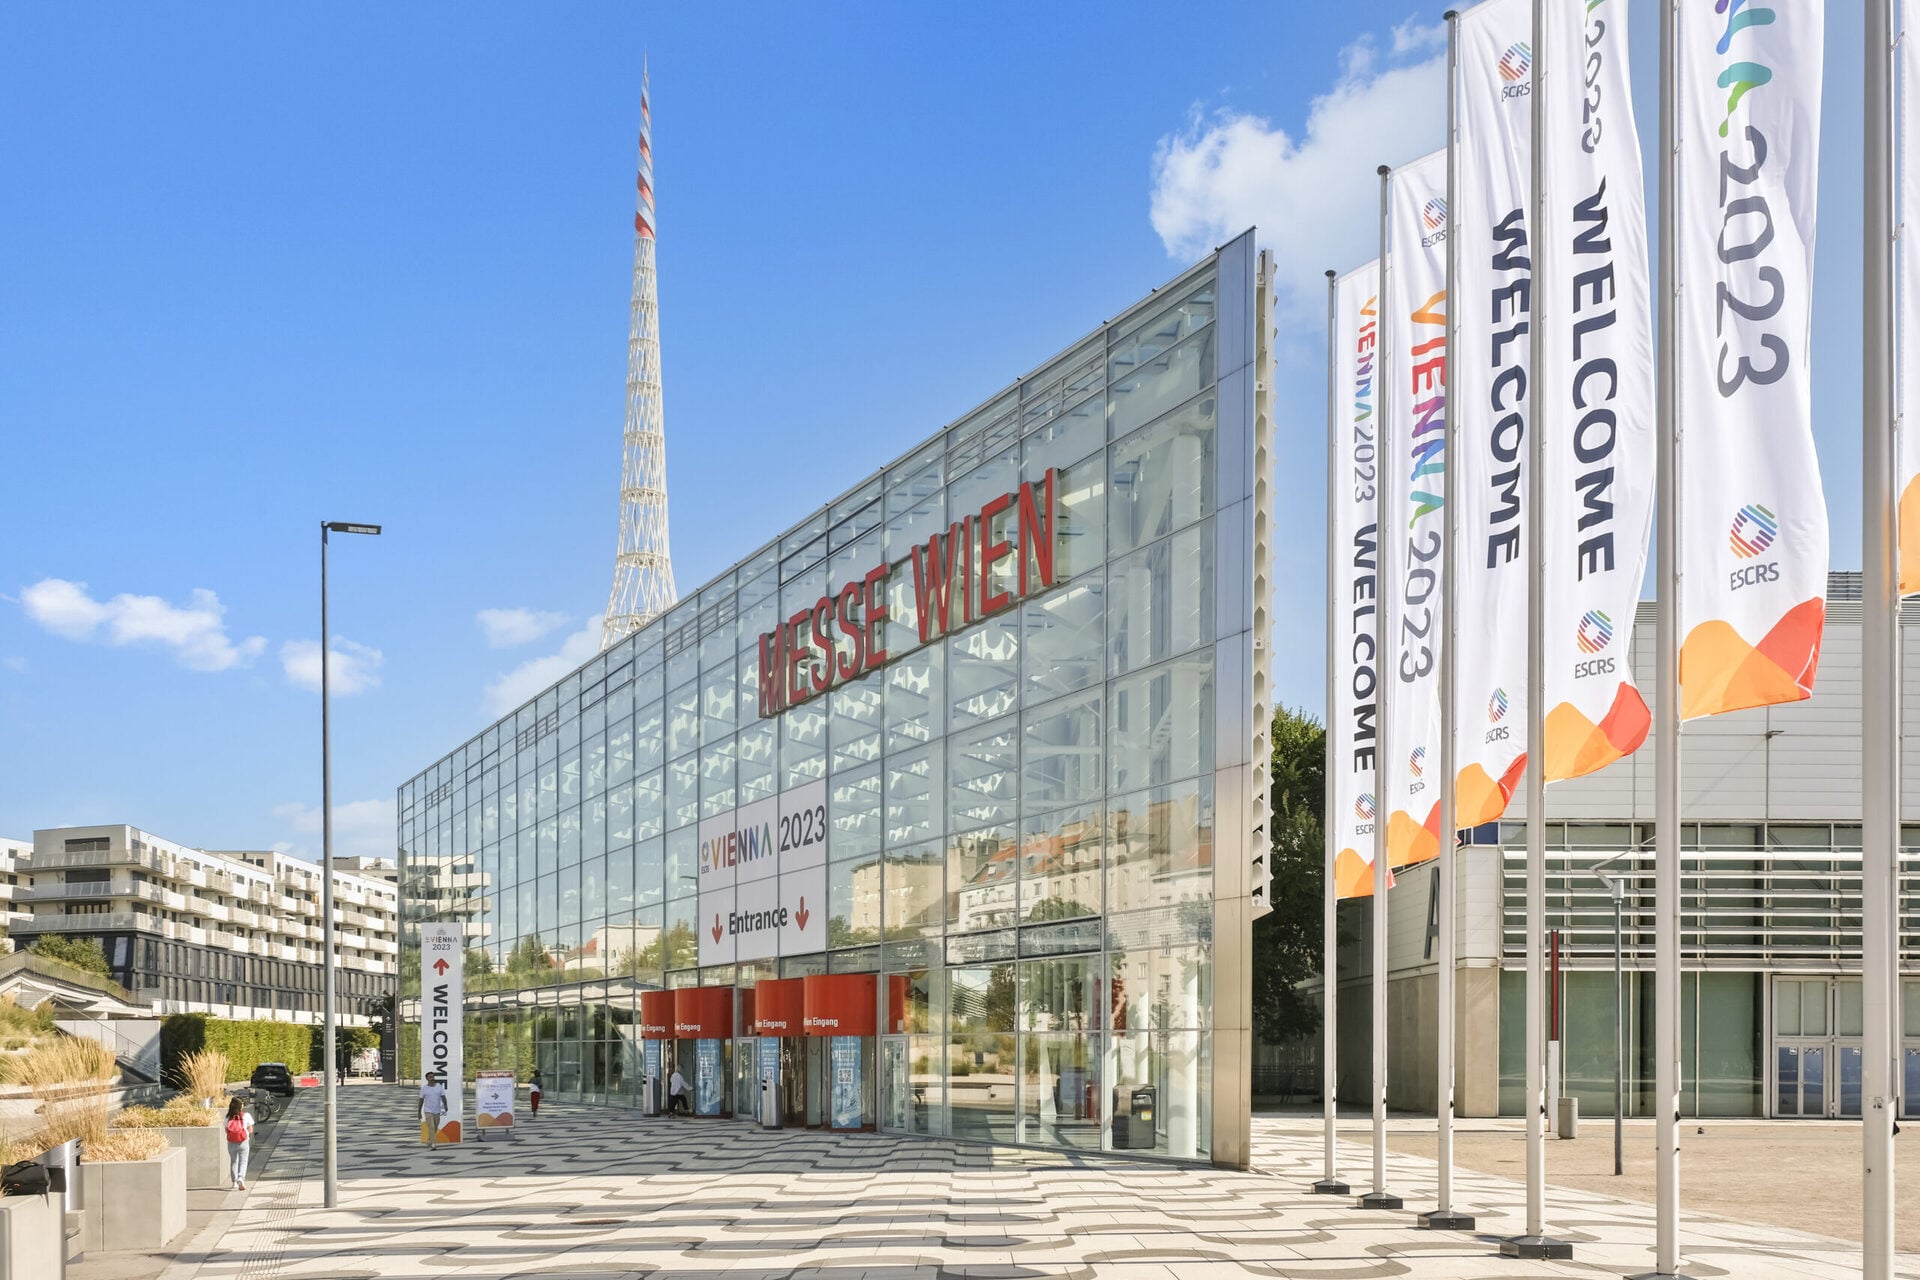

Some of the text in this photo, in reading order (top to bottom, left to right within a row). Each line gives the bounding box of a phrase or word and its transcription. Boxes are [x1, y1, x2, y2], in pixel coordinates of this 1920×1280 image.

[1716, 125, 1790, 398] 2023
[1487, 208, 1531, 569] WELCOME
[1572, 175, 1618, 582] WELCOME
[1400, 290, 1447, 683] VIENNA 2023
[1353, 294, 1377, 774] VIENNA 2023 WELCOME
[758, 467, 1058, 718] MESSE WIEN
[1730, 562, 1780, 591] ESCRS
[1574, 657, 1616, 679] ESCRS
[711, 805, 826, 871] VIENNA 2023
[432, 943, 451, 951] 2023
[729, 907, 788, 935] Entrance
[763, 1019, 787, 1029] Eingang
[813, 1017, 838, 1027] Eingang
